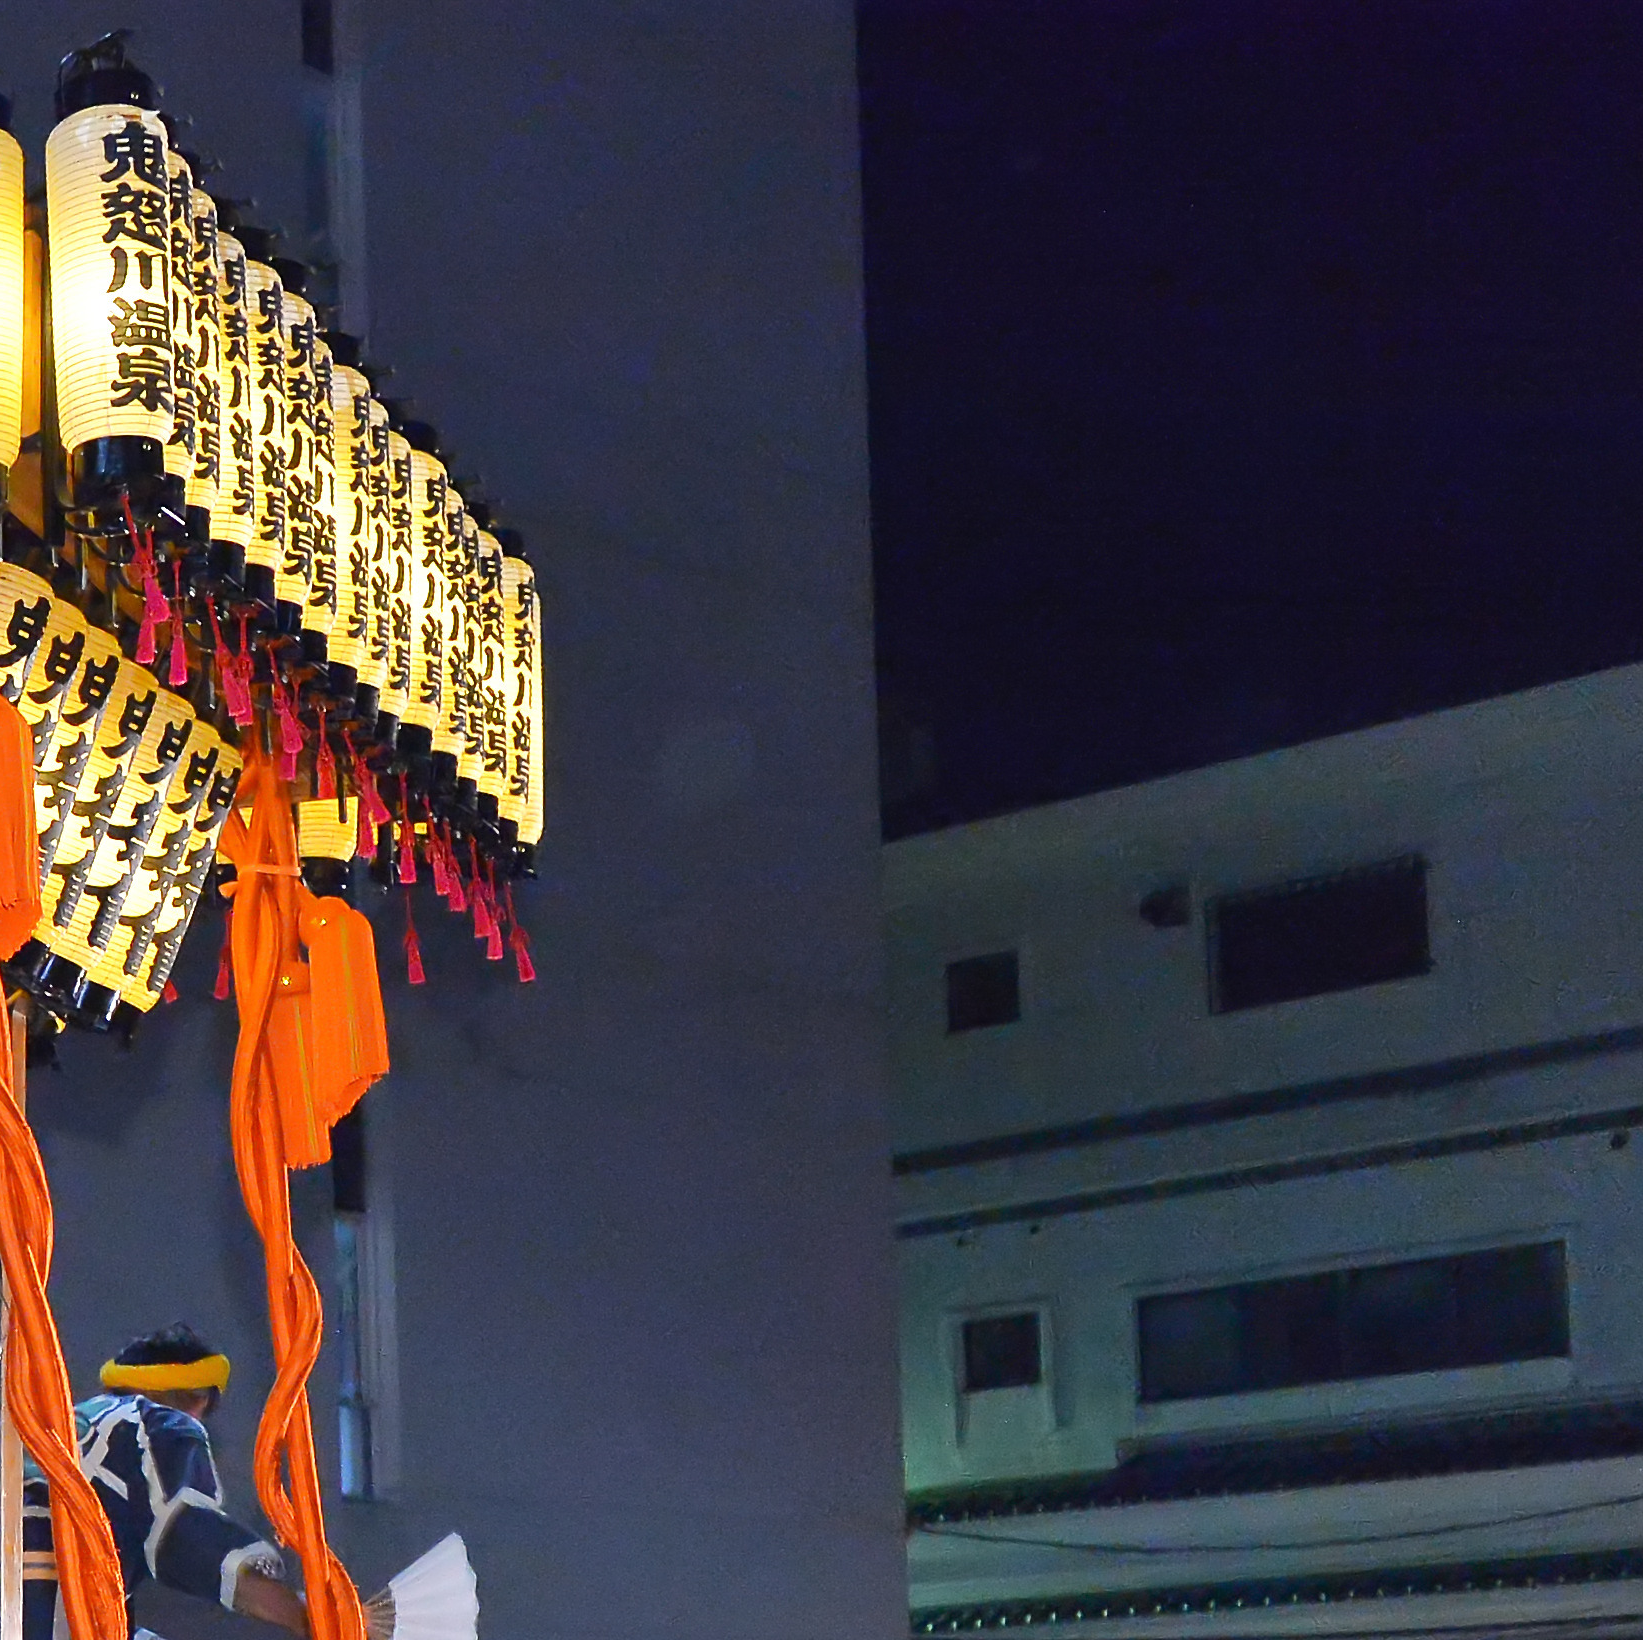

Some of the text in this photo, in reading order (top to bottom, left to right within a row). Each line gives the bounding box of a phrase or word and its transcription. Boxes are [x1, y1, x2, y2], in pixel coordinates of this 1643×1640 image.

[100, 121, 173, 414] 鬼怒川温泉
